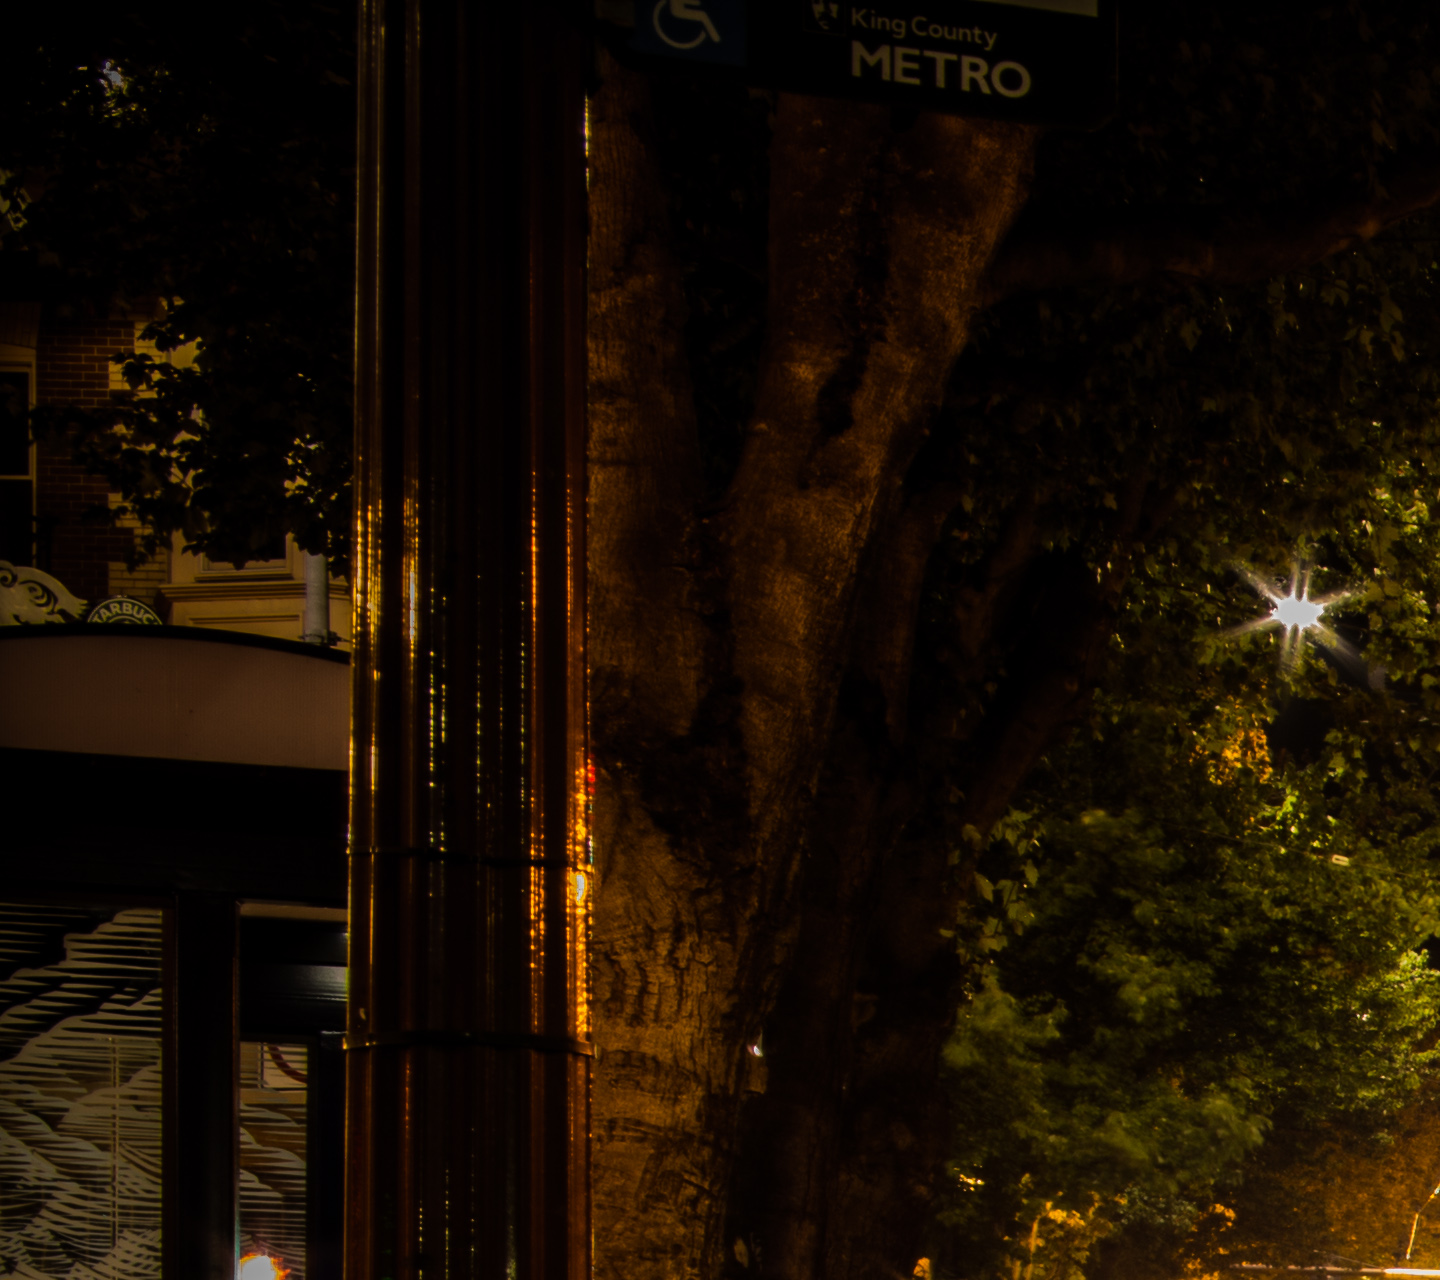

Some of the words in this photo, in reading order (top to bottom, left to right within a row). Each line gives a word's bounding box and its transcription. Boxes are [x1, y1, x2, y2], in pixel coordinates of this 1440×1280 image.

[851, 7, 908, 39] King
[911, 15, 999, 51] County
[851, 39, 1033, 100] METRO
